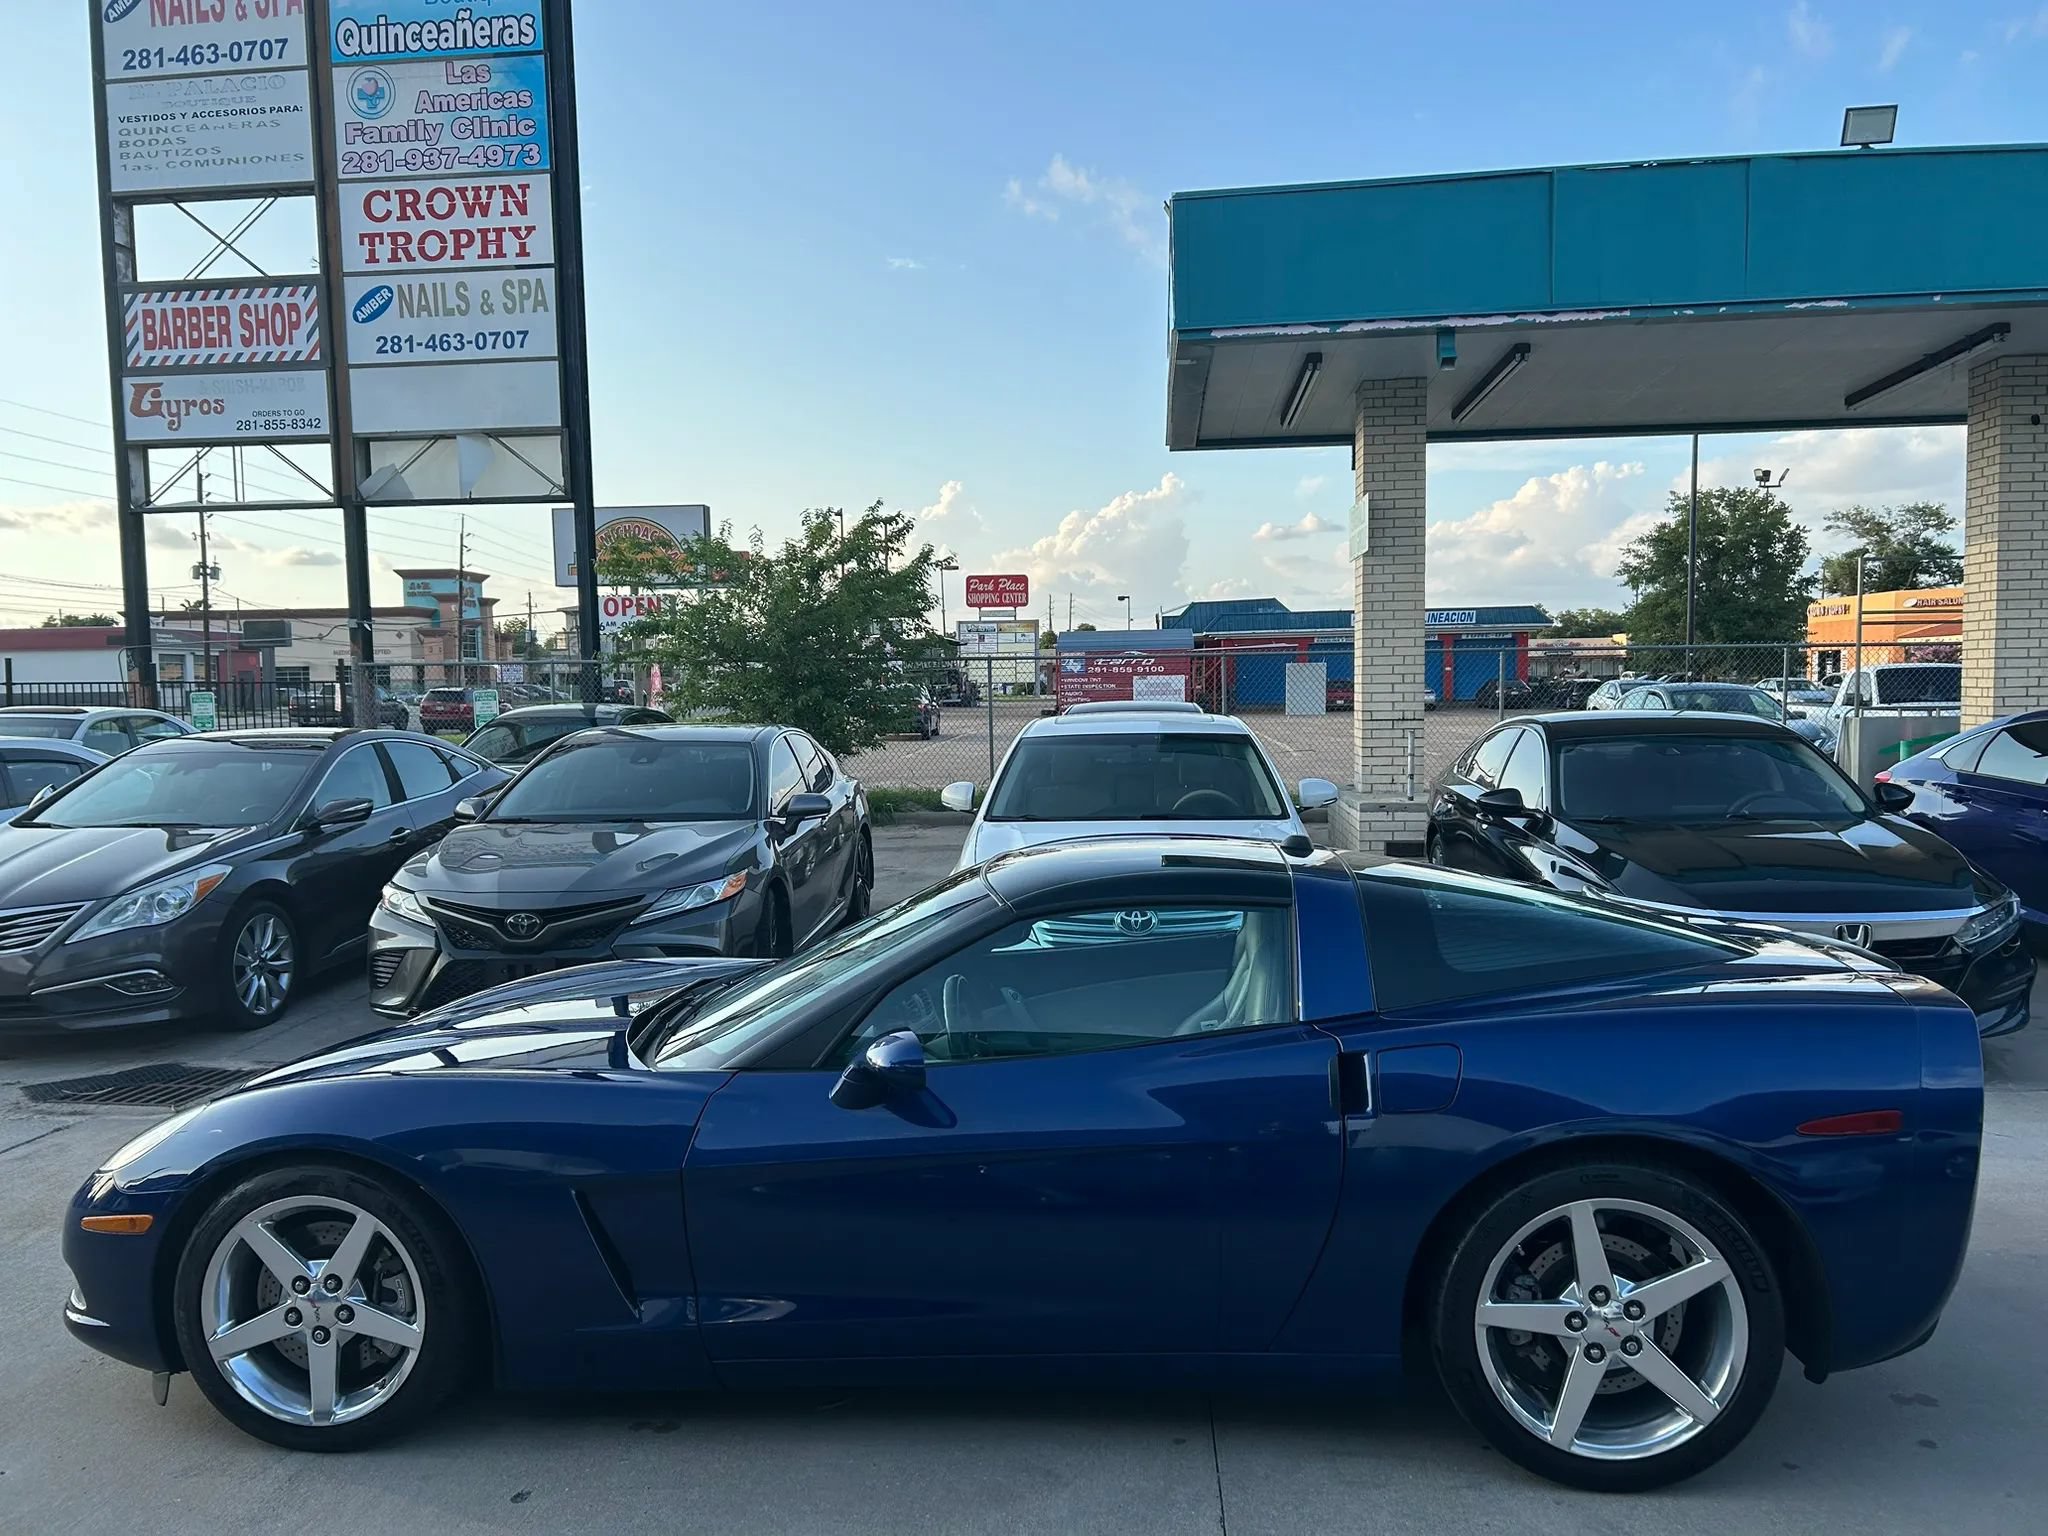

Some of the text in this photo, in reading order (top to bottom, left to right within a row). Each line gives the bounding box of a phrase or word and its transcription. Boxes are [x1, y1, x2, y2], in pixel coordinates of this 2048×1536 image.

[336, 8, 536, 56] Quinceañeras
[122, 38, 289, 70] 281-463-0707
[445, 61, 491, 84] Las
[415, 88, 533, 113] Americas
[118, 113, 176, 123] VESTIDOS
[191, 107, 266, 119] ACCESORIOS
[269, 105, 303, 114] PARA:
[118, 136, 187, 148] BODAS
[344, 115, 536, 146] Family Clinic
[119, 146, 222, 160] BAUTIZOS
[165, 153, 305, 169] COMUNIONES
[342, 144, 541, 174] 281-937-4973
[362, 184, 531, 223] CROWN
[358, 225, 537, 264] TROPHY
[354, 278, 549, 322] AMBER NAILS & SPA
[141, 302, 302, 351] BARBER SHOP
[375, 330, 530, 355] 281-463-0707
[129, 382, 225, 431] Gyros
[252, 409, 282, 417] ORDERS
[283, 409, 293, 417] TO
[236, 417, 322, 431] 281-855-8342
[969, 577, 1025, 592] Park Place
[603, 597, 661, 617] OPEN
[967, 592, 1027, 604] SHOPPING CENTER
[1425, 611, 1475, 623] INEACION
